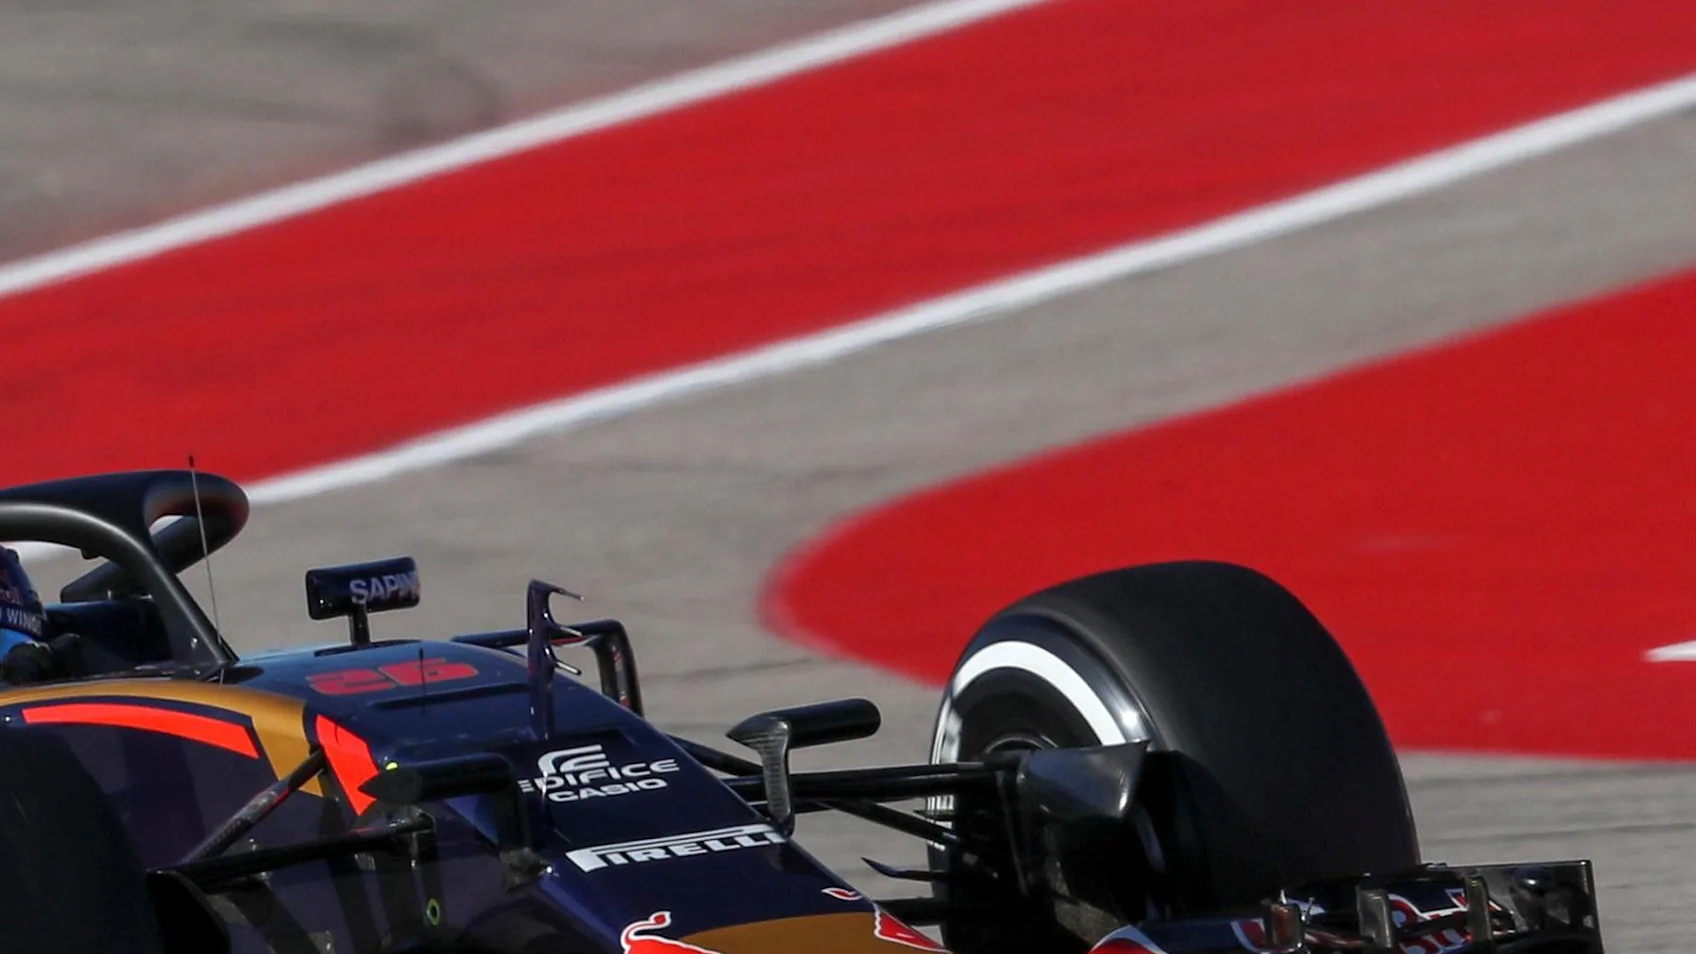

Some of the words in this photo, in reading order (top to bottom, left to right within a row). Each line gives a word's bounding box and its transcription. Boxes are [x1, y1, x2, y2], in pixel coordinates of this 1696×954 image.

[517, 758, 680, 793] EDIFICE
[548, 778, 668, 802] CASIO
[565, 823, 787, 873] PIRELLI
